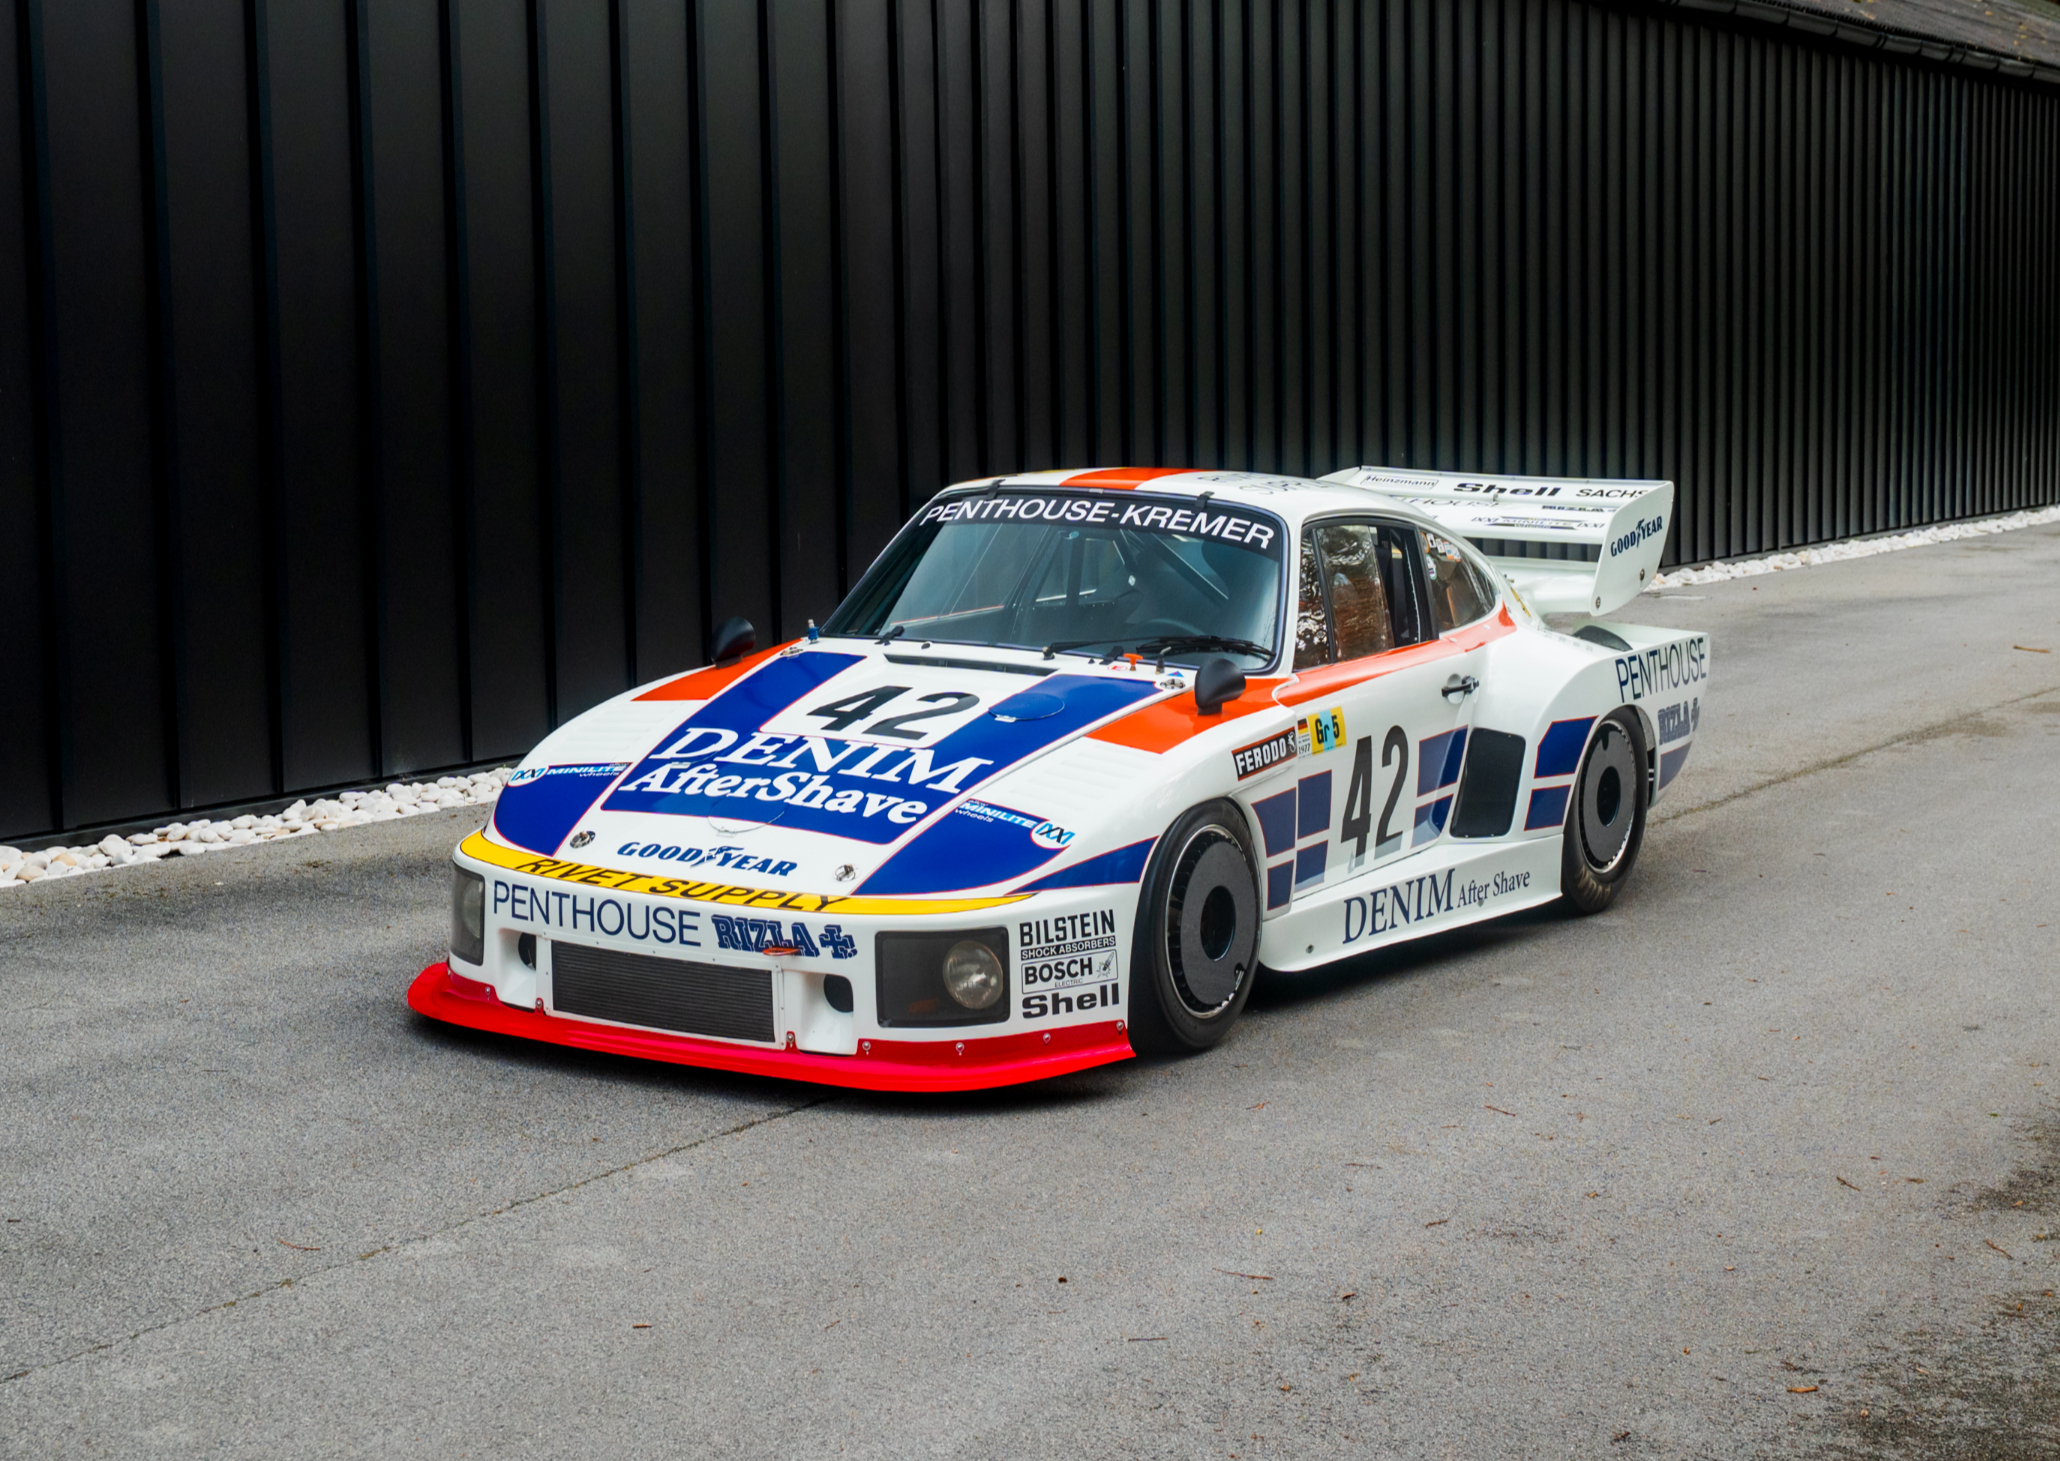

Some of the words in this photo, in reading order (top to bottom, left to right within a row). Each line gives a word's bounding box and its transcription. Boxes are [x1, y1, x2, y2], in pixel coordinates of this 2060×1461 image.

[1366, 474, 1436, 487] Heinzmann
[1453, 482, 1561, 497] Shell
[919, 498, 1275, 549] PENTHOUSE-KREMER
[1610, 515, 1663, 557] GOODYEAR
[1615, 637, 1707, 703] PENTHOUSE
[806, 685, 981, 741] 42
[1315, 718, 1330, 744] Gr
[1332, 714, 1340, 740] 5
[547, 765, 626, 776] MINILITE
[649, 727, 994, 794] DENIM
[1235, 737, 1287, 775] FERODO
[1340, 725, 1409, 868] 42
[955, 808, 994, 823] wheels
[958, 802, 1039, 829] MINILITE
[617, 841, 798, 877] GOODYEAR
[515, 858, 646, 889] RIVET
[648, 880, 851, 911] SUPPLY
[494, 880, 702, 947] PENTHOUSE
[1342, 868, 1455, 944] DENIM
[1457, 880, 1490, 909] After
[1492, 871, 1530, 897] Shave
[1019, 909, 1115, 948] BILSTEIN
[1022, 946, 1057, 960] SHOCK
[1058, 937, 1116, 955] ABSORBERS
[1024, 956, 1093, 986] BOSCH
[1054, 978, 1084, 988] ELECTRIC
[1022, 982, 1120, 1019] Shell
